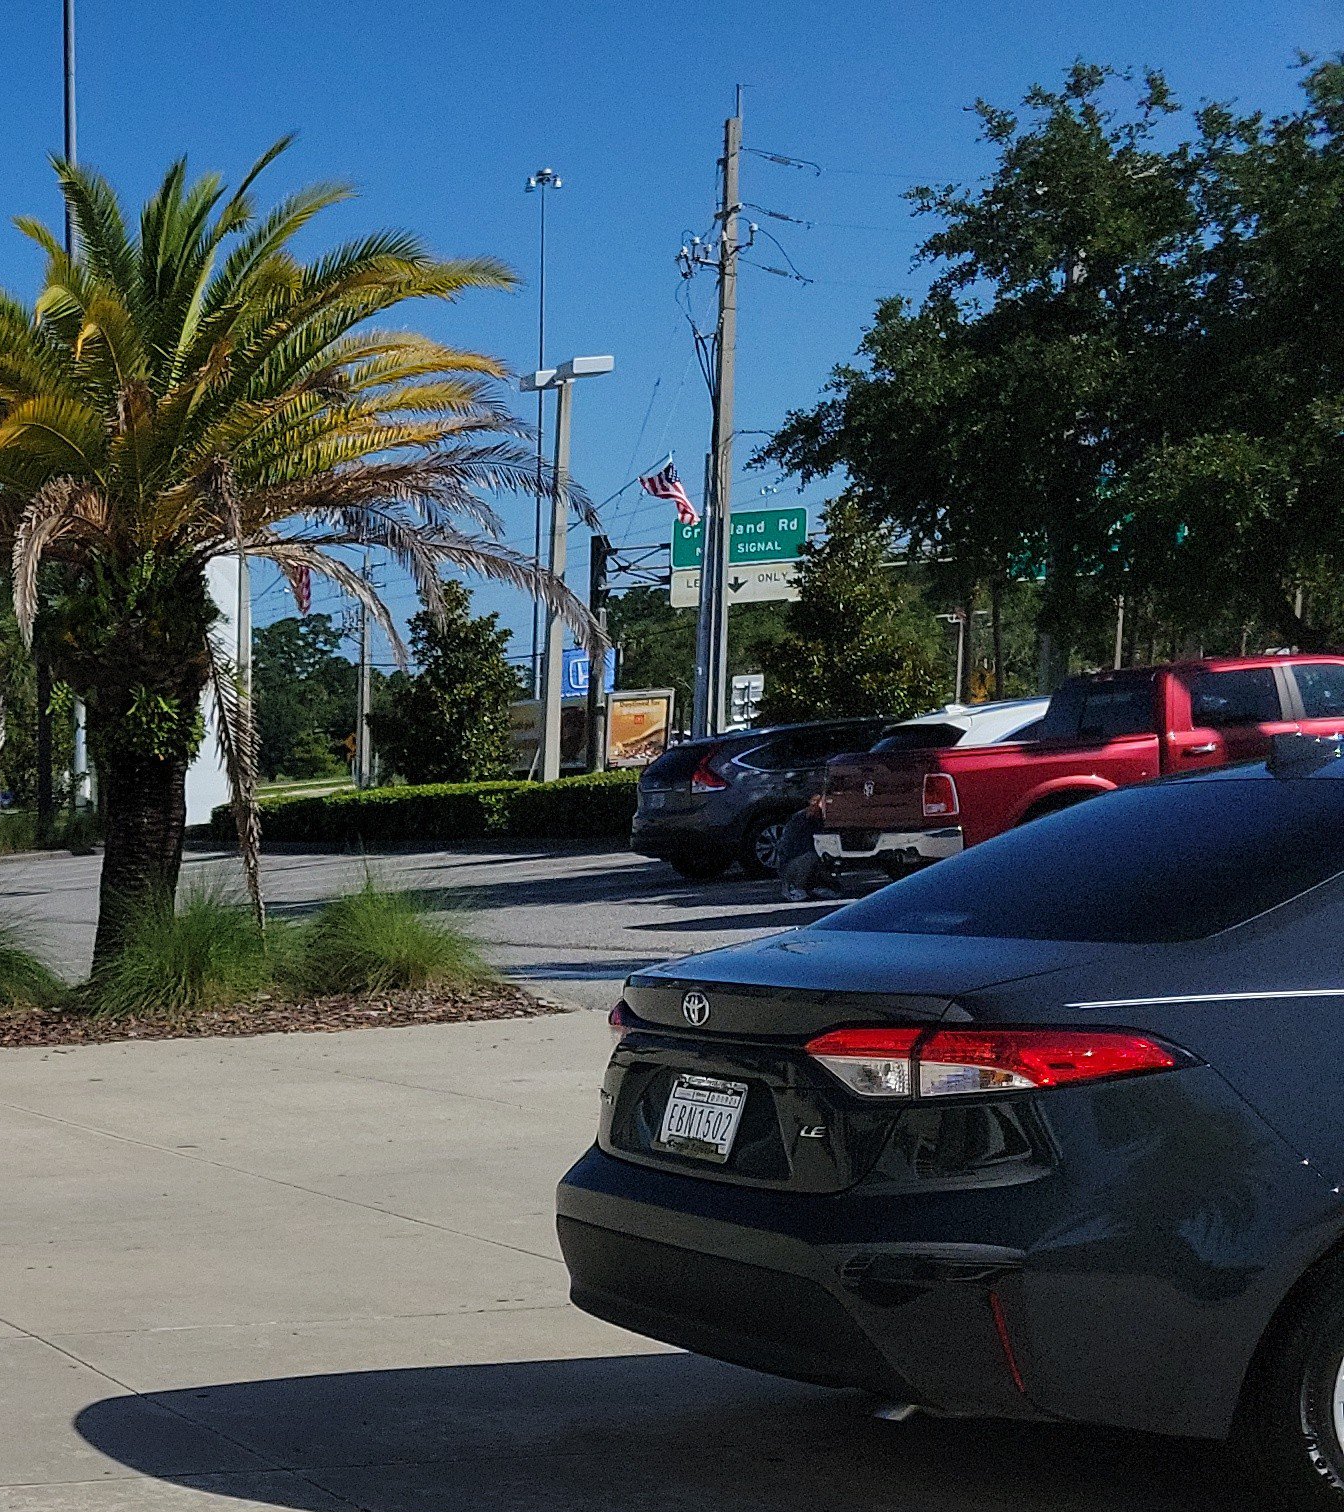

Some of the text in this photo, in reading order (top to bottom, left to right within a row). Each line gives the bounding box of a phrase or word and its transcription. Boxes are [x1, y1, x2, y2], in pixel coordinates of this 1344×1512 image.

[682, 517, 798, 540] Grland Rd
[737, 540, 782, 554] SIGNAL
[757, 572, 788, 583] ONLY
[667, 1103, 733, 1142] EBN1502
[799, 1125, 827, 1138] LE
